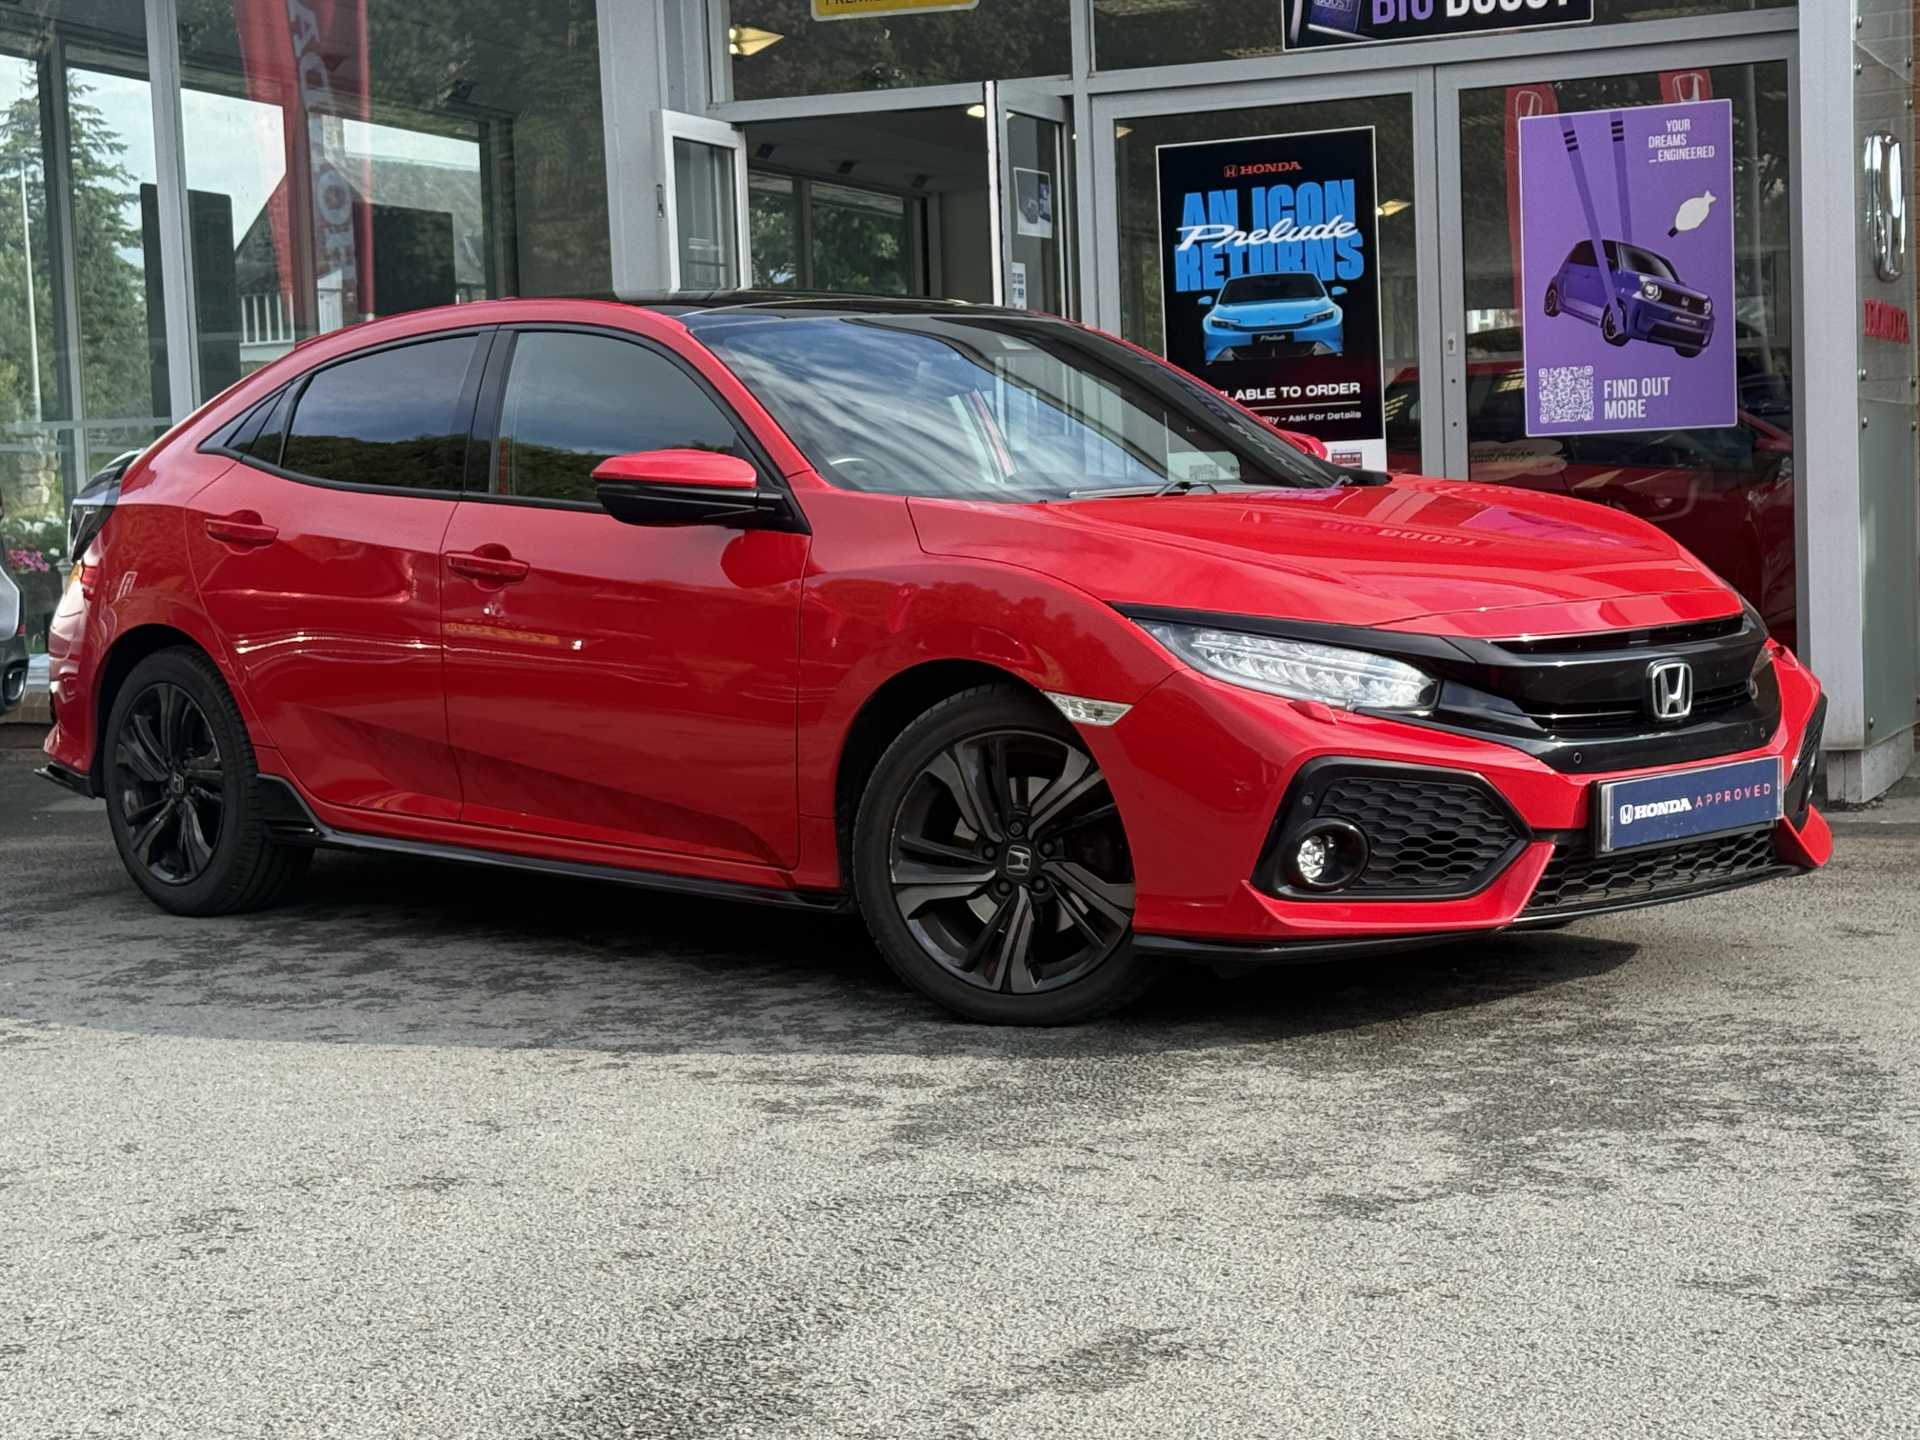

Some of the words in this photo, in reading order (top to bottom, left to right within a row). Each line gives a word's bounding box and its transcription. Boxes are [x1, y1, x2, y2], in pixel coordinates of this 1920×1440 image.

[1666, 118, 1691, 132] YOUR
[1648, 134, 1688, 149] DREAMS
[1240, 161, 1302, 175] HONDA
[1181, 189, 1239, 242] AN
[1252, 179, 1357, 236] ICON
[1177, 215, 1359, 251] Prelude
[1174, 232, 1365, 293] RETURNS
[1280, 386, 1301, 398] TO
[1306, 382, 1361, 397] ORDER
[1604, 378, 1638, 400] FIND
[1641, 376, 1671, 397] OUT
[1287, 412, 1308, 422] Ask
[1309, 412, 1325, 422] For
[1604, 399, 1647, 421] MORE
[1634, 797, 1692, 819] HONDA
[1695, 782, 1772, 808] APPROVED
